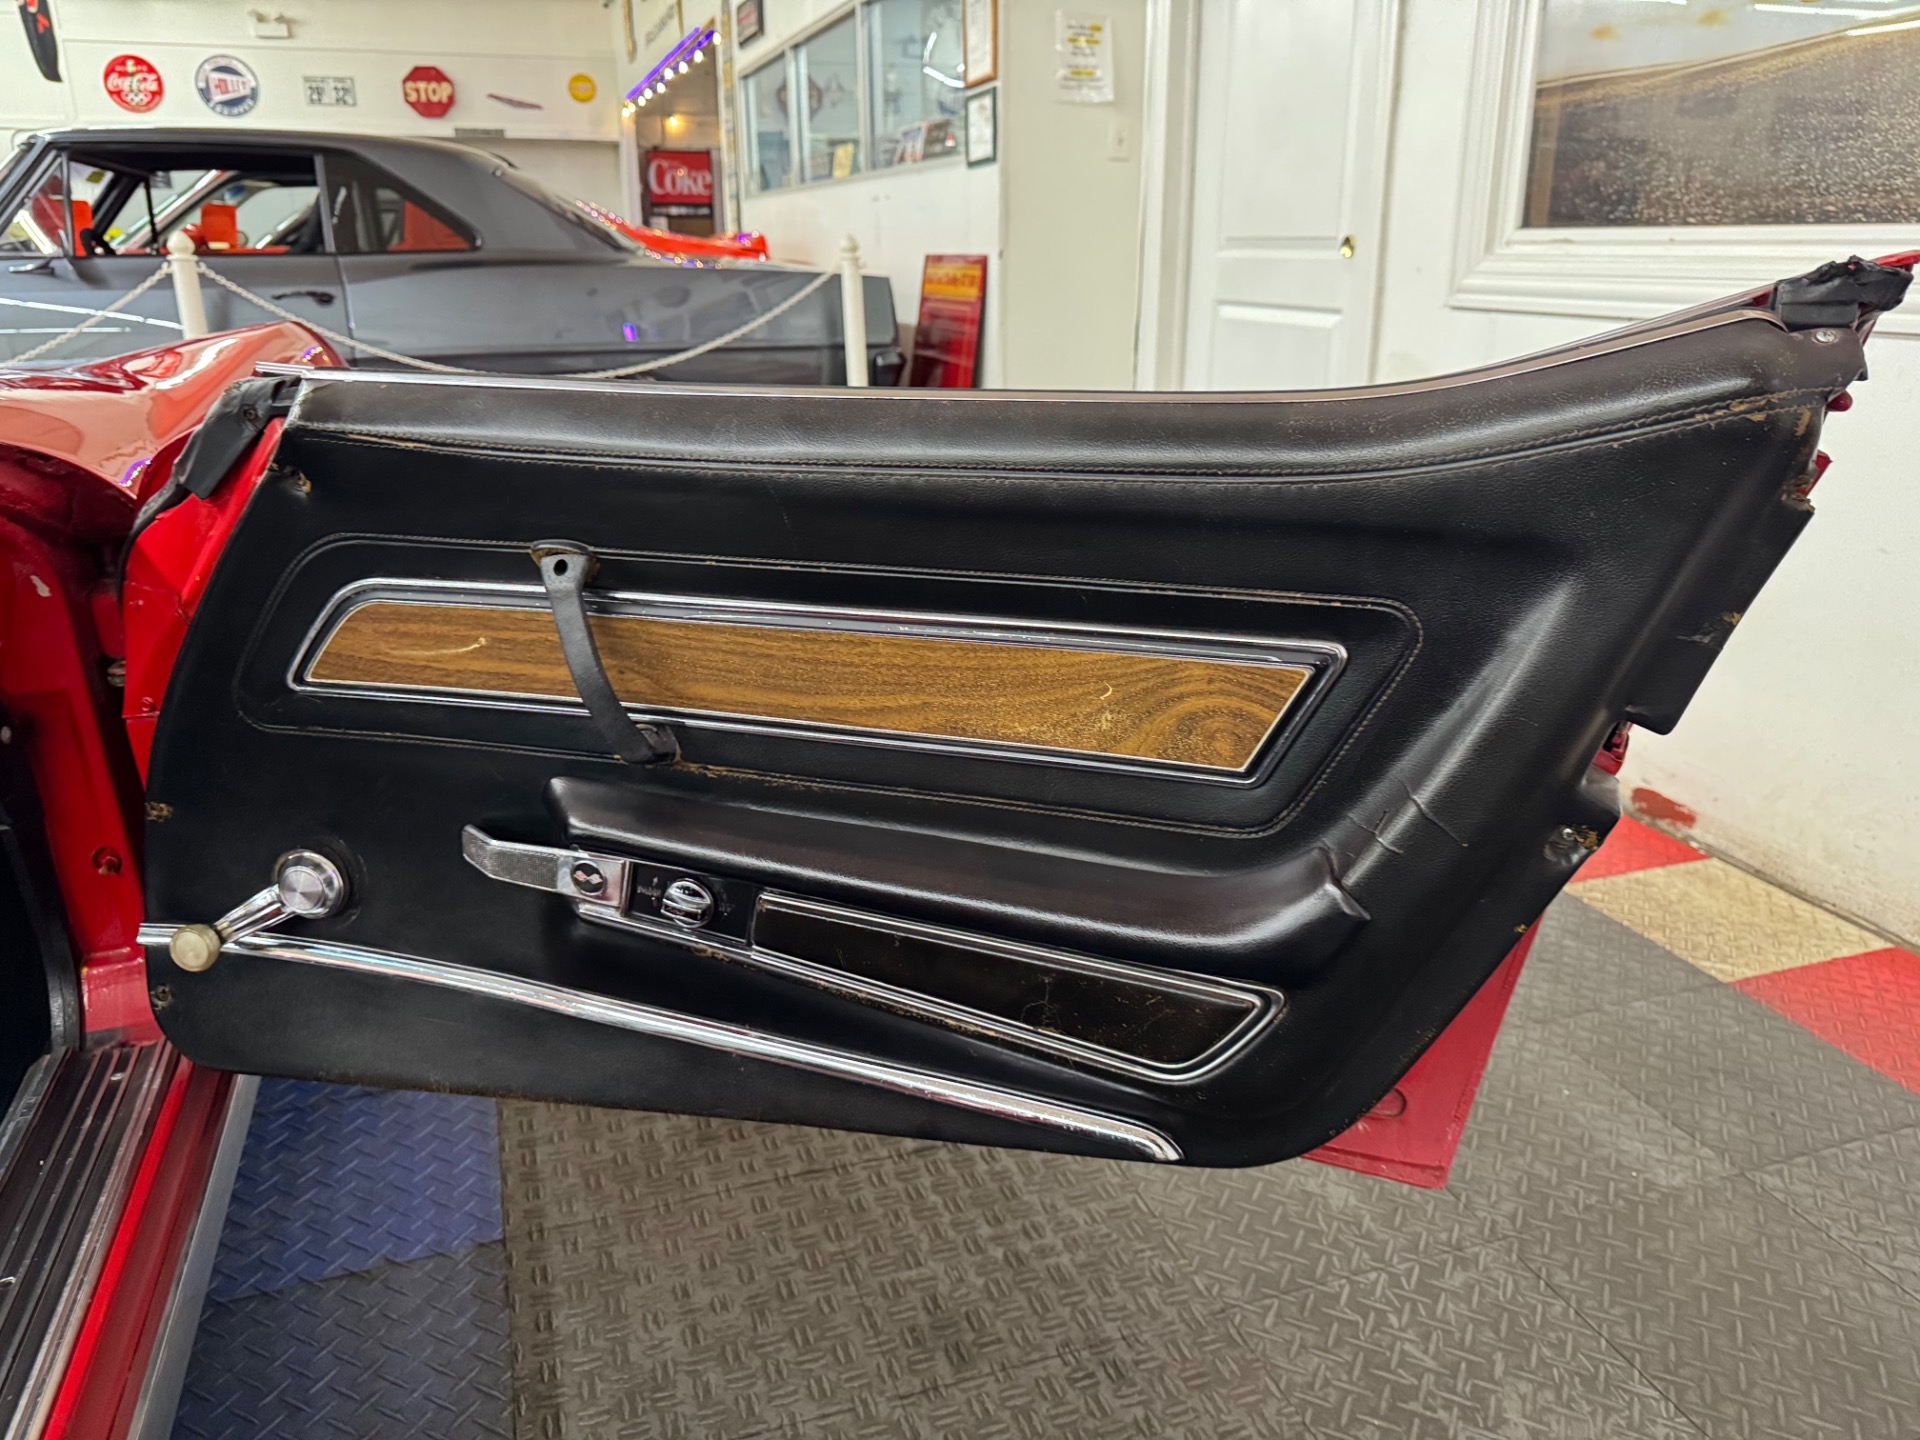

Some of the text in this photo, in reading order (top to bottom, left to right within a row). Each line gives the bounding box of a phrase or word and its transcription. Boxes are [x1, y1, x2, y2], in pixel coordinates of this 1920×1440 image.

[106, 72, 158, 92] CocaCola
[404, 80, 453, 104] STOP
[648, 158, 712, 196] Coke
